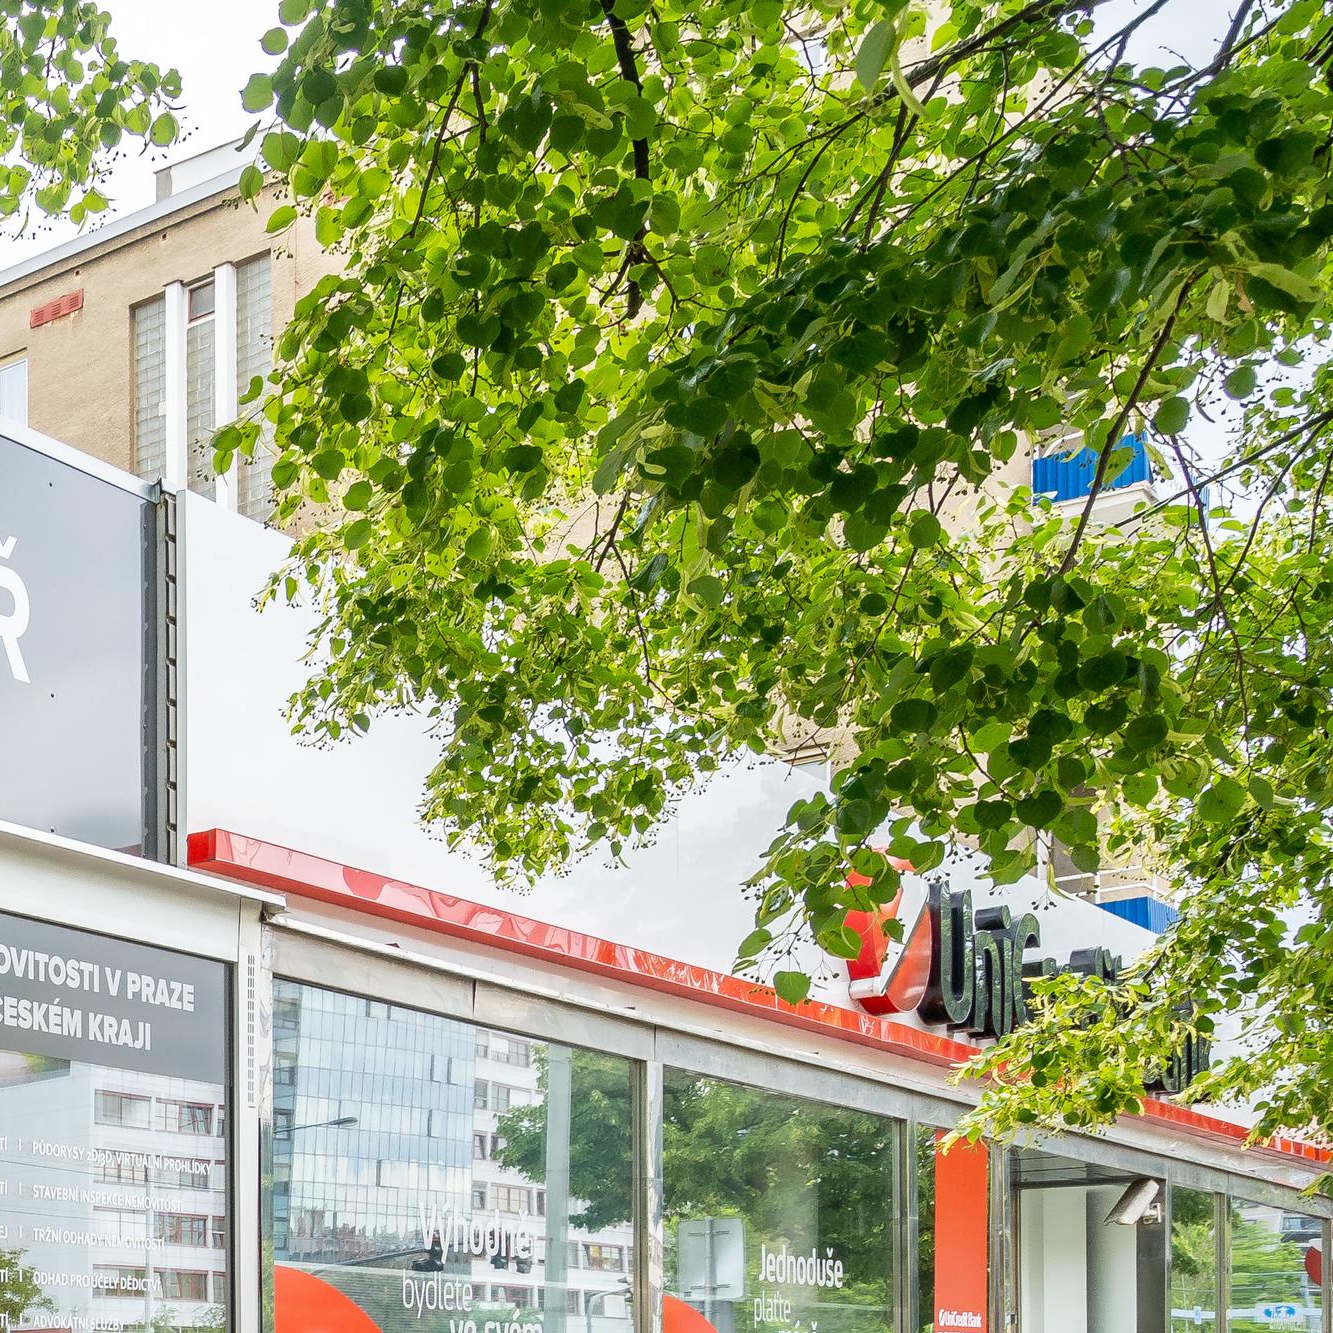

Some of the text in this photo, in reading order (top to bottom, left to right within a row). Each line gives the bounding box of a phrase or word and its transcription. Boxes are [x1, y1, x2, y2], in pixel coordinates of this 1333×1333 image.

[106, 967, 121, 995] V
[126, 971, 195, 1012] PRAZE
[88, 1013, 151, 1051] KRAJI
[33, 1139, 84, 1160] PŮDORYSY
[116, 1152, 163, 1169] VIRTUÁLNÍ
[164, 1158, 212, 1176] PROHLÍDKY
[33, 1183, 78, 1202] STAVEBNÍ
[79, 1190, 124, 1206] INSPEKCE
[33, 1225, 62, 1242] TRŽNÍ
[64, 1231, 100, 1247] ODHADY
[419, 1199, 534, 1265] Výhodně
[33, 1270, 161, 1292] ODHAD PRO ÚČELY DĚDICTVÍ
[758, 1243, 844, 1288] Jednoduše
[403, 1267, 473, 1319] bydlete
[754, 1292, 791, 1327] plaťte
[33, 1312, 89, 1330] ADVOKÁTNÍ
